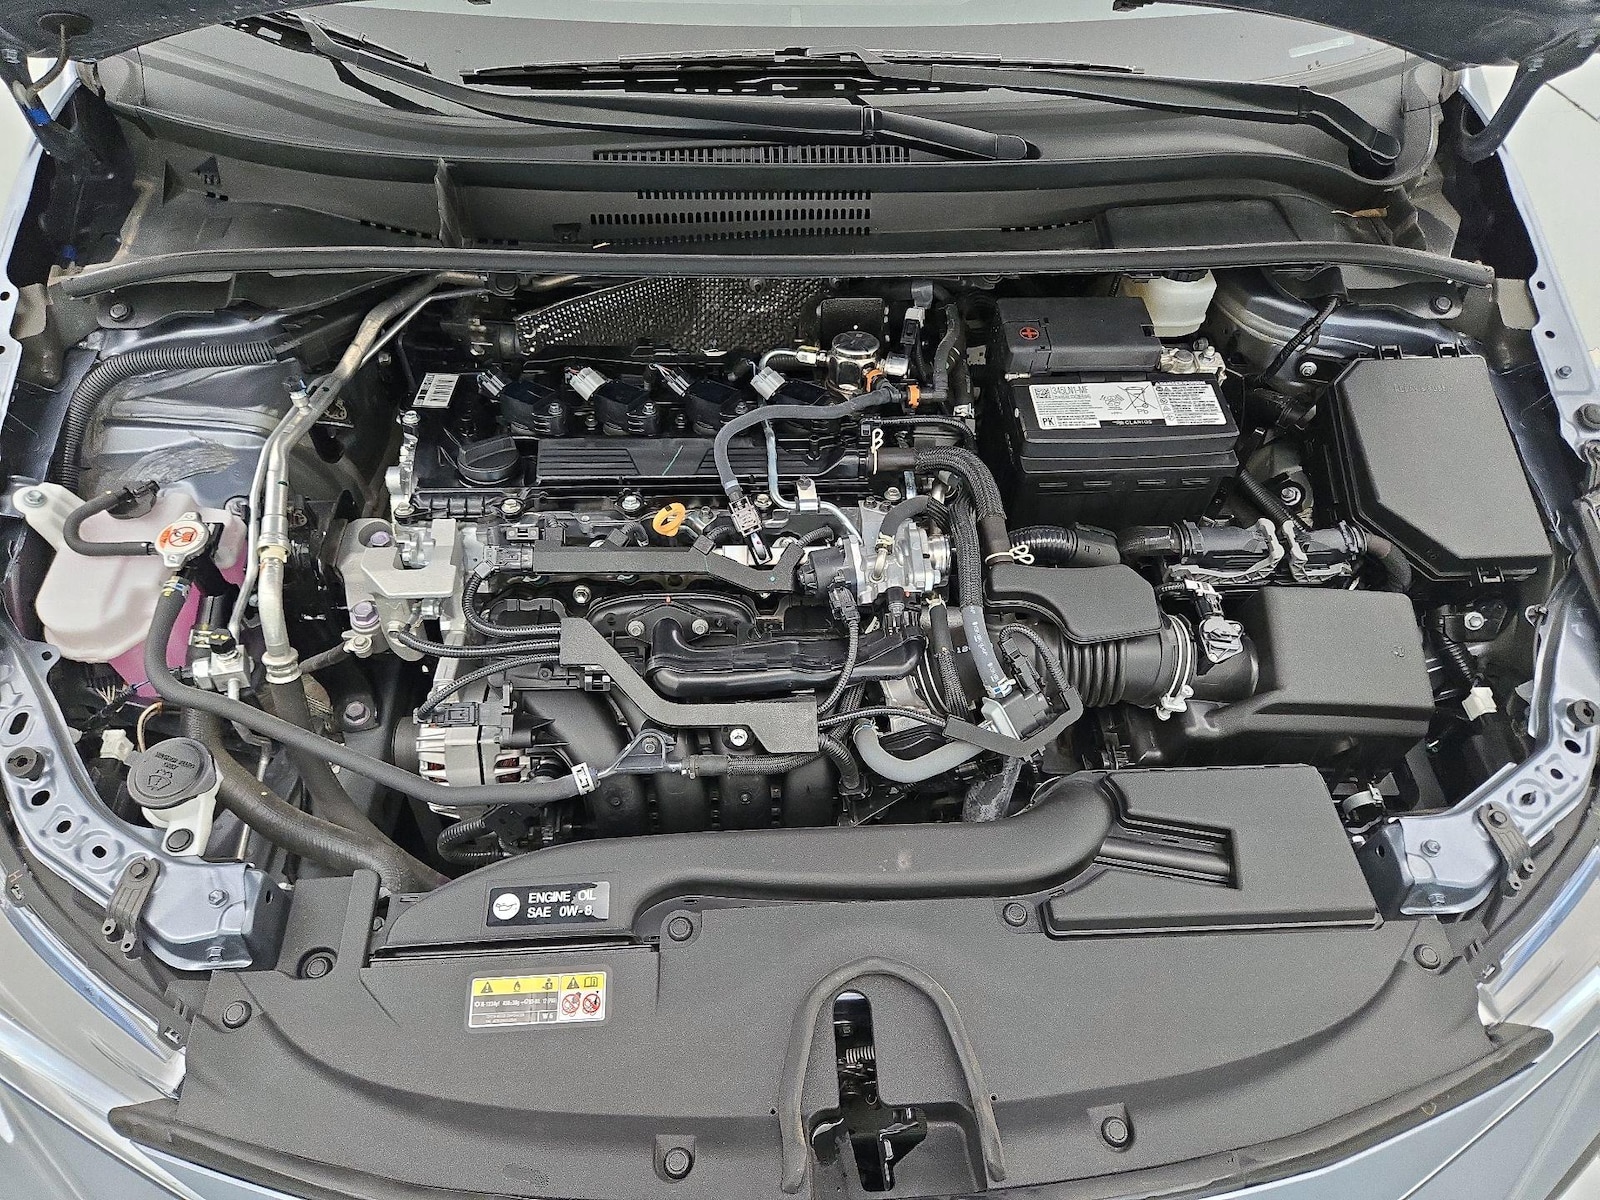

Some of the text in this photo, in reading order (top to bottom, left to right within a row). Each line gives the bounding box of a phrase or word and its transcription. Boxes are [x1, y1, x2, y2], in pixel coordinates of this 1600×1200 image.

[1042, 417, 1055, 426] PK
[528, 889, 596, 903] ENGINE OIL
[527, 904, 593, 918] SAE 0W-8
